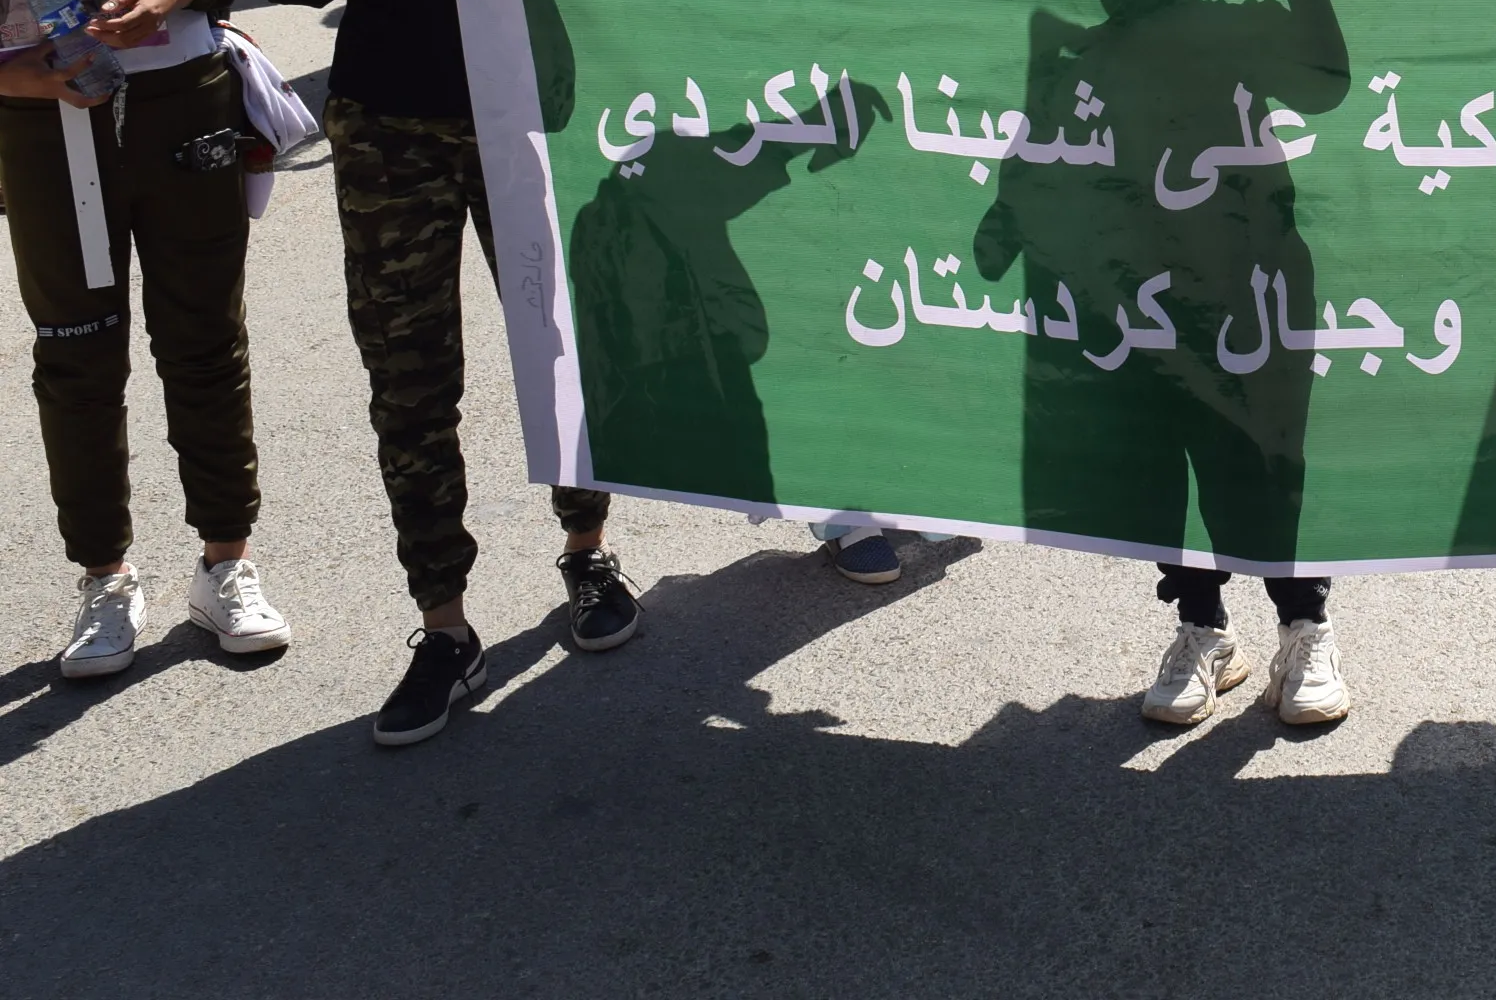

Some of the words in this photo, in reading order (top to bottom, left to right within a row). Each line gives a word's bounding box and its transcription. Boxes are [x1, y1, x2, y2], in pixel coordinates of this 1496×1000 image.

[597, 62, 860, 179] الكردي
[897, 72, 1116, 186] شعبنا
[1154, 81, 1317, 211] على
[57, 320, 100, 338] SPORT
[845, 246, 1178, 371] كردستان
